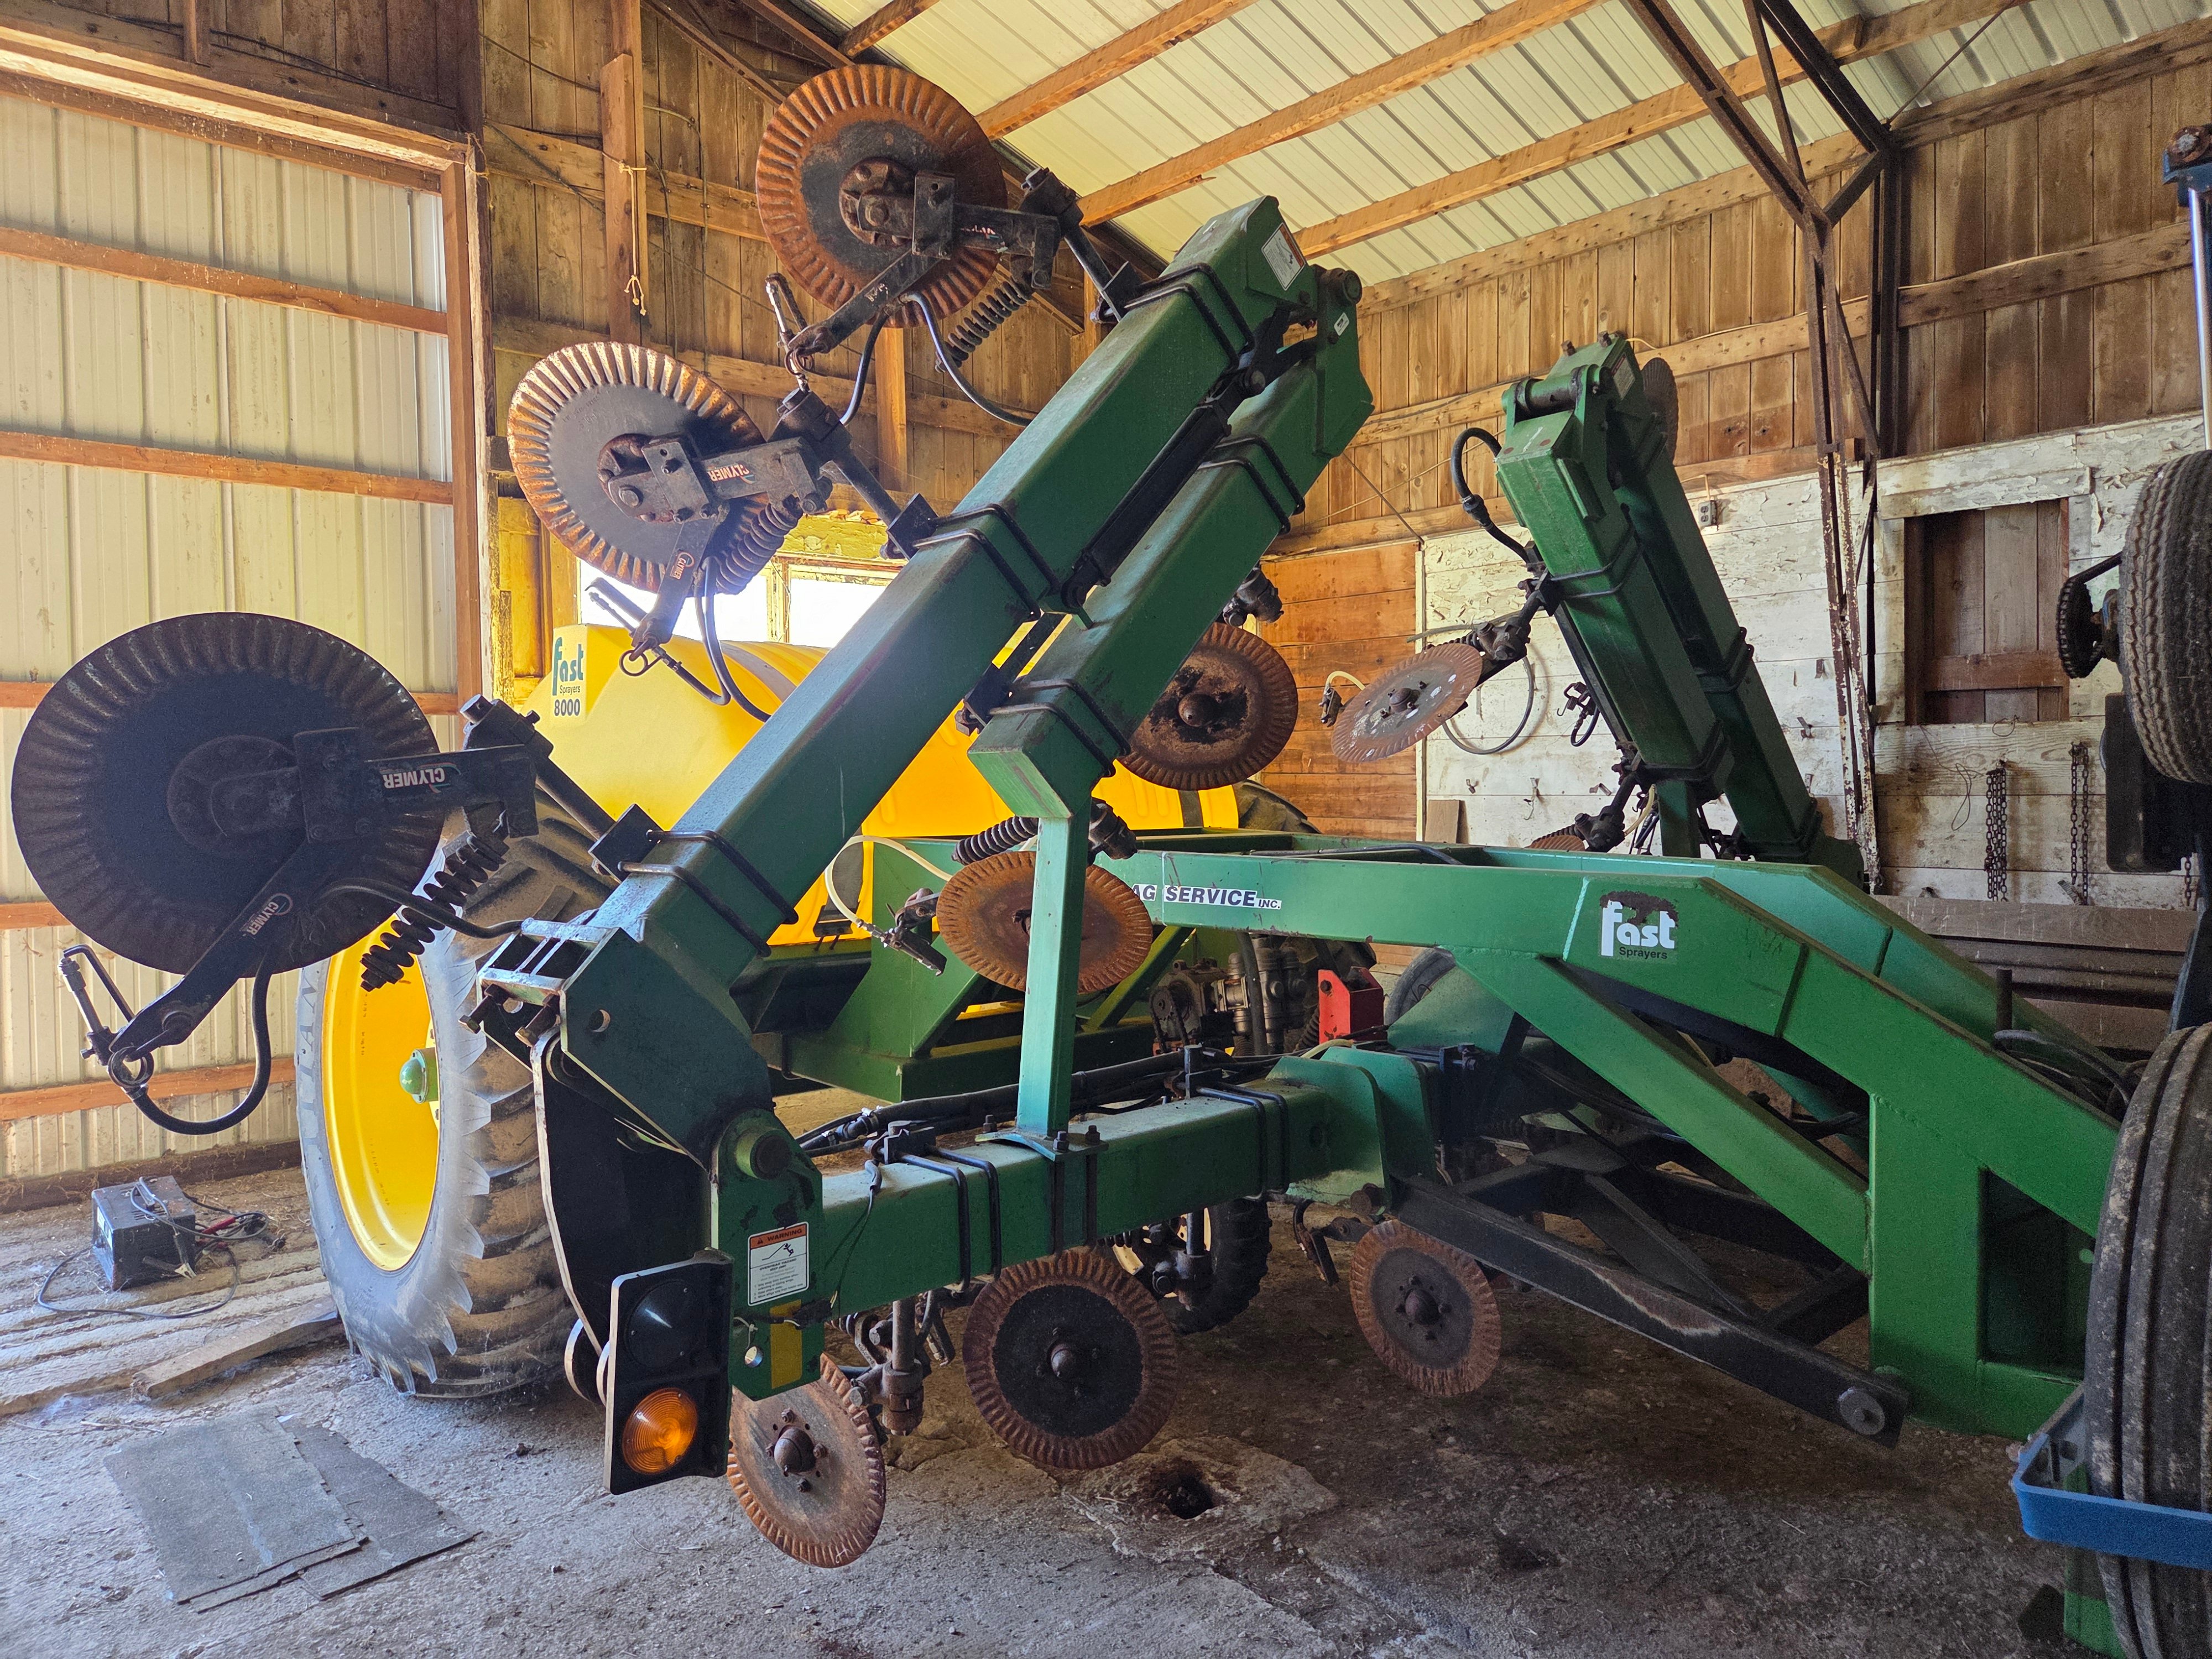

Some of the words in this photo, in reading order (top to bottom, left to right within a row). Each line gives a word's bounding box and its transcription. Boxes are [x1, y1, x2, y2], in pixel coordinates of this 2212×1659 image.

[707, 465, 750, 482] CLYMER
[552, 637, 584, 696] fast
[560, 685, 581, 696] Sprayers
[554, 698, 581, 717] 8000
[382, 768, 445, 789] CLYMER
[1166, 886, 1256, 907] SERVICE
[1258, 899, 1280, 909] INC.
[246, 901, 279, 935] CLYMER
[1601, 899, 1676, 957] fast
[1619, 946, 1668, 959] Sprayers
[767, 1228, 802, 1241] WARNING
